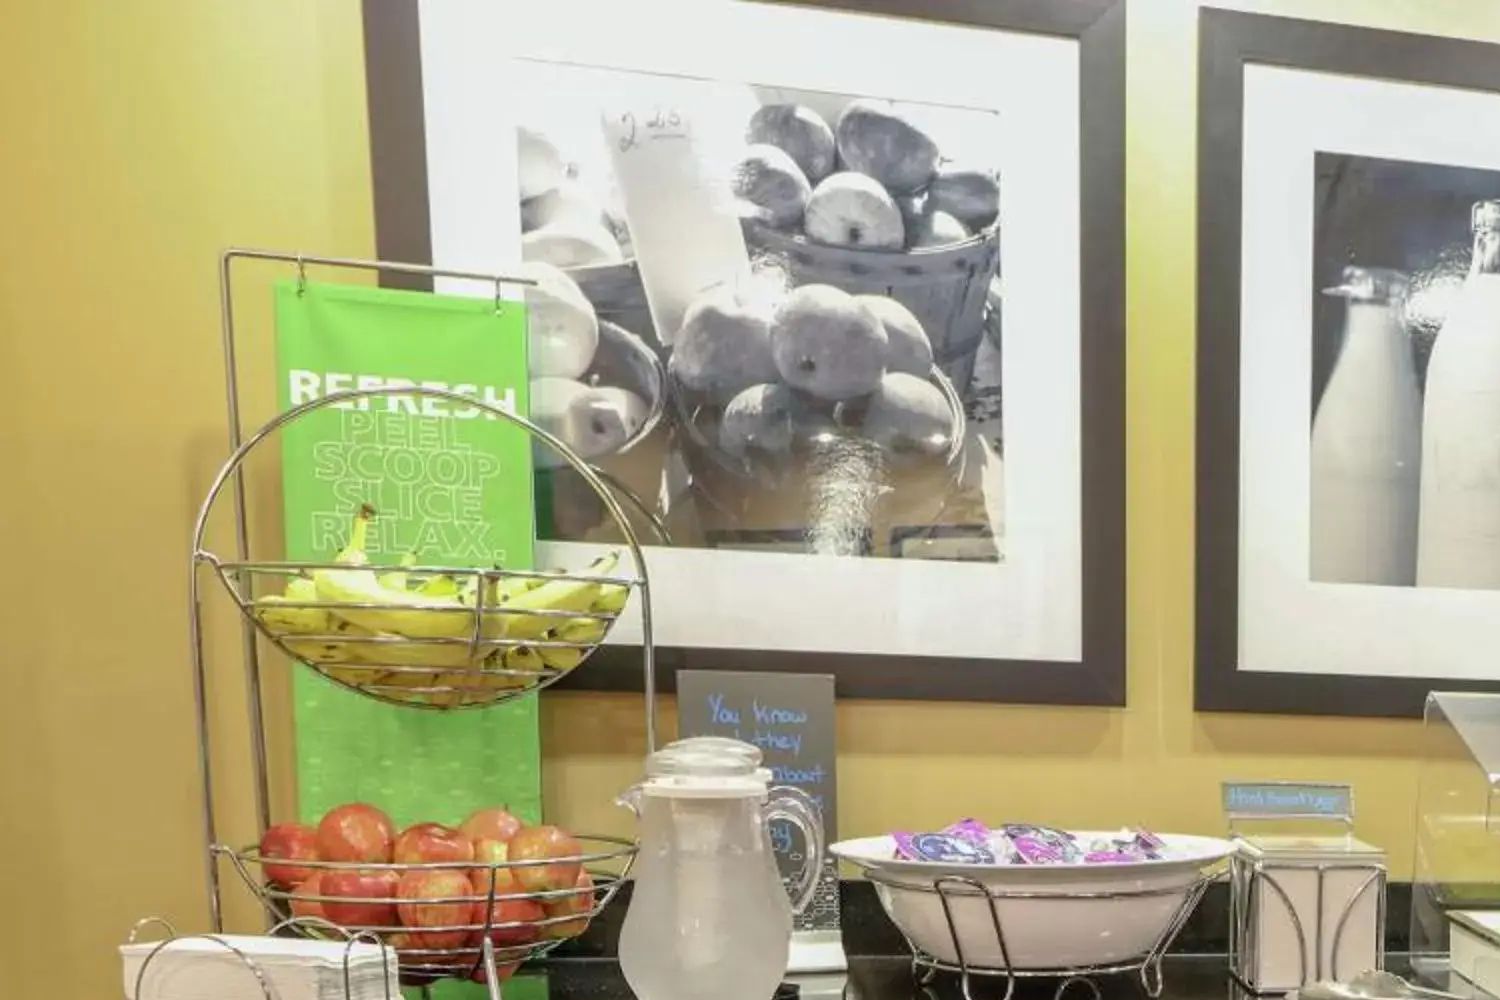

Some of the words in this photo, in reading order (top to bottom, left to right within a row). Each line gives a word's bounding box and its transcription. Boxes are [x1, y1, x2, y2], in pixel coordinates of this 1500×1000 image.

[289, 369, 519, 421] REFRESH
[341, 408, 471, 453] PEEL
[313, 441, 501, 489] SCOOP
[333, 478, 483, 525] SLICE
[311, 512, 507, 561] RELAX.
[708, 692, 740, 723] You
